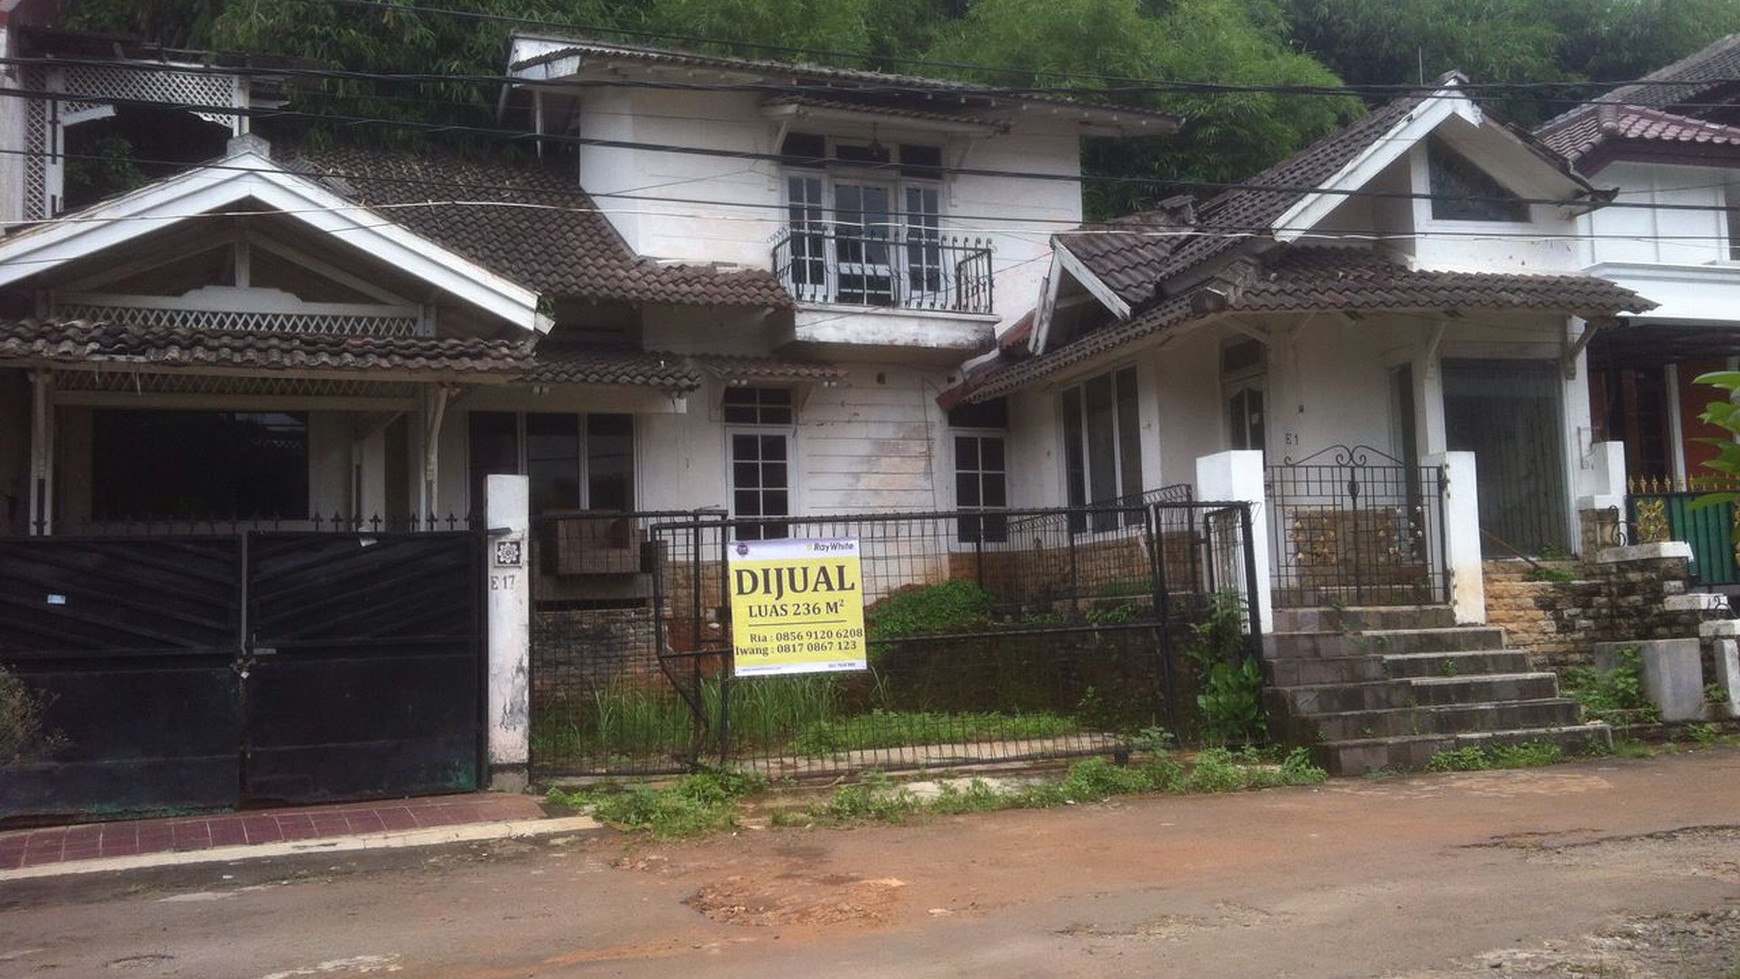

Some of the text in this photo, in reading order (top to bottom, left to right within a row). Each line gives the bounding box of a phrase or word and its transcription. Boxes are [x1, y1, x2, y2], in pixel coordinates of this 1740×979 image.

[735, 564, 856, 601] DIJUAL
[748, 604, 789, 618] LUAS
[792, 602, 822, 616] 236
[749, 633, 768, 643] Ria
[775, 631, 804, 642] 0856
[805, 629, 833, 640] 9120
[835, 628, 863, 639] 6208
[735, 645, 769, 657] Iwang
[776, 643, 804, 654] 0817
[806, 642, 834, 652] 0867
[837, 640, 857, 651] 123
